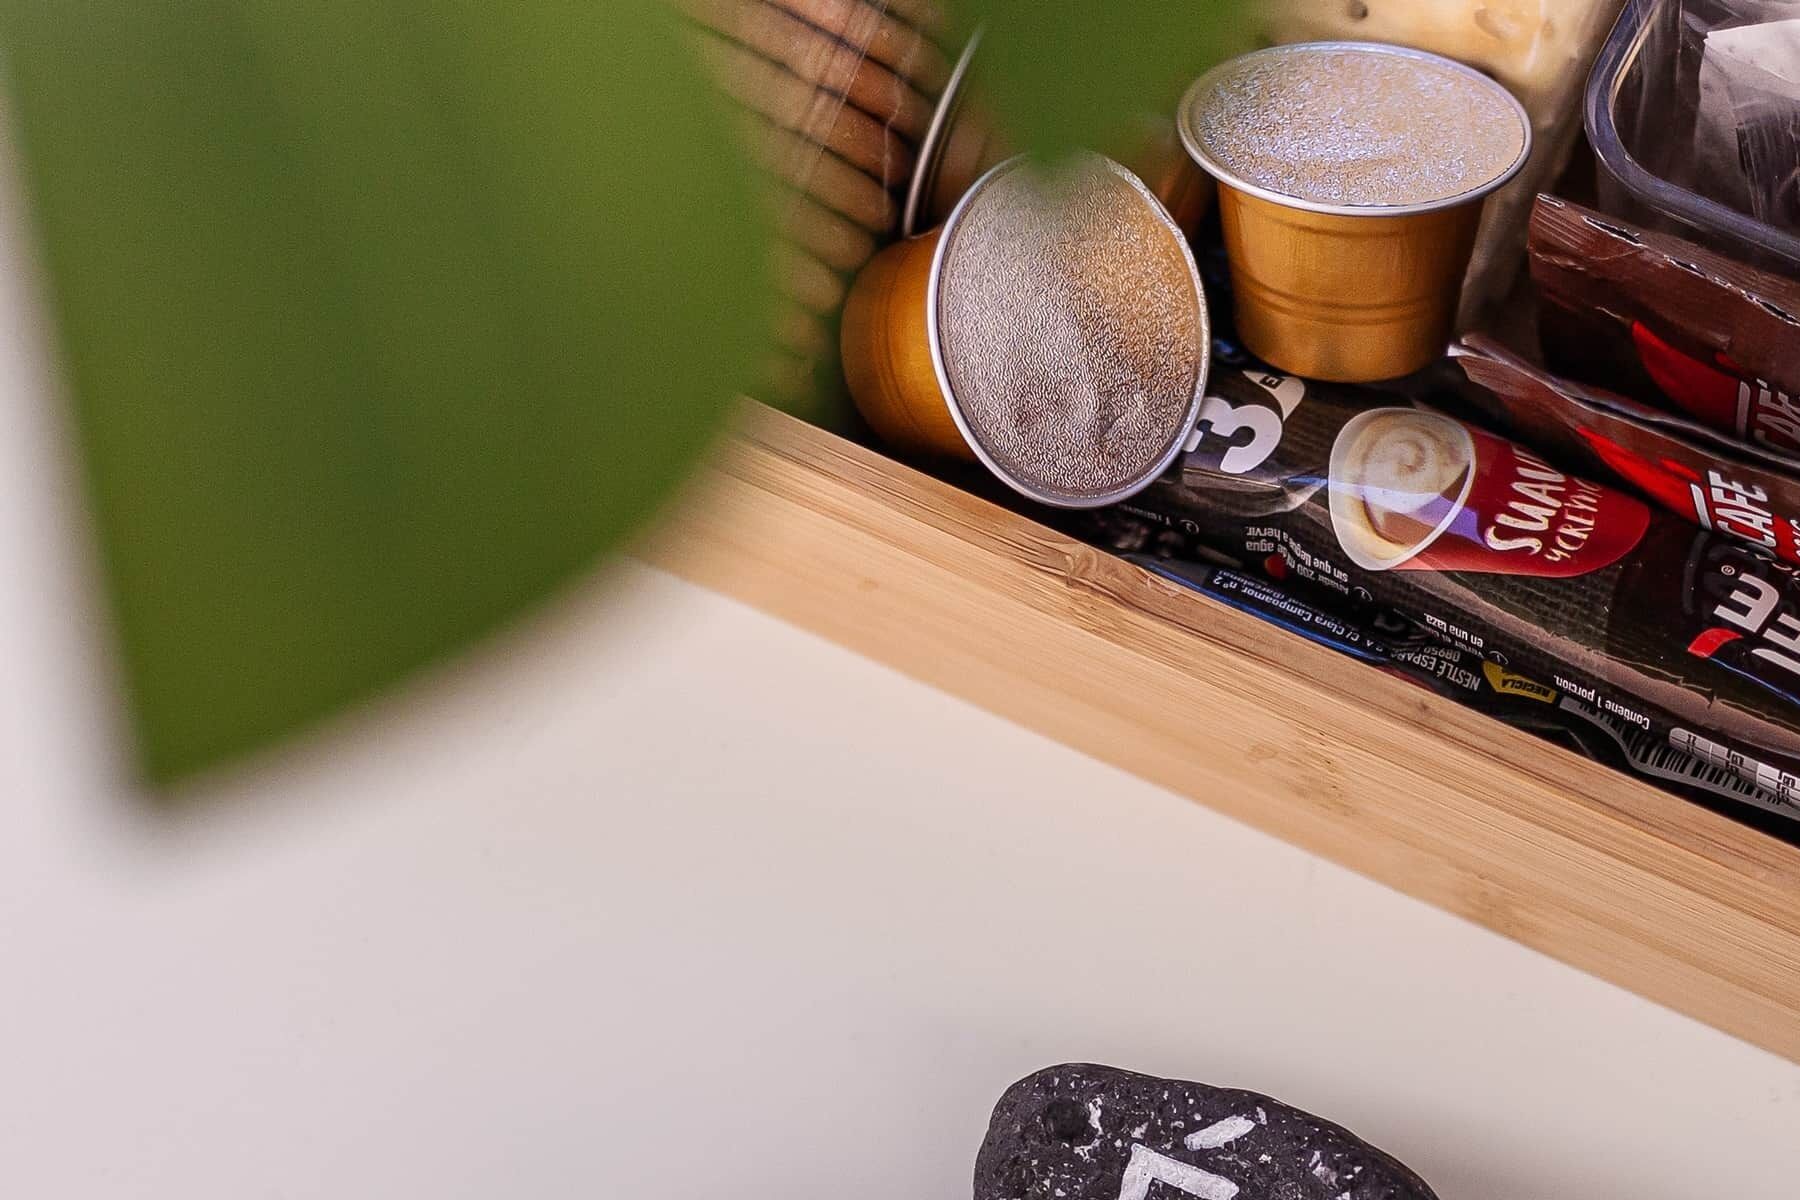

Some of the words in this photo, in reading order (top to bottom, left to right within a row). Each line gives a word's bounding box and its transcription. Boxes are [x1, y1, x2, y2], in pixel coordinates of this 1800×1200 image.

[1184, 396, 1283, 474] 3
[1244, 540, 1274, 553] agua
[1311, 555, 1334, 574] que
[1211, 573, 1223, 586] 2
[1330, 566, 1350, 583] sin
[1312, 614, 1345, 636] Clara
[1446, 623, 1469, 640] una
[1468, 634, 1484, 647] en
[1436, 661, 1481, 690] NESTLÉ
[1604, 699, 1651, 730] Contiene
